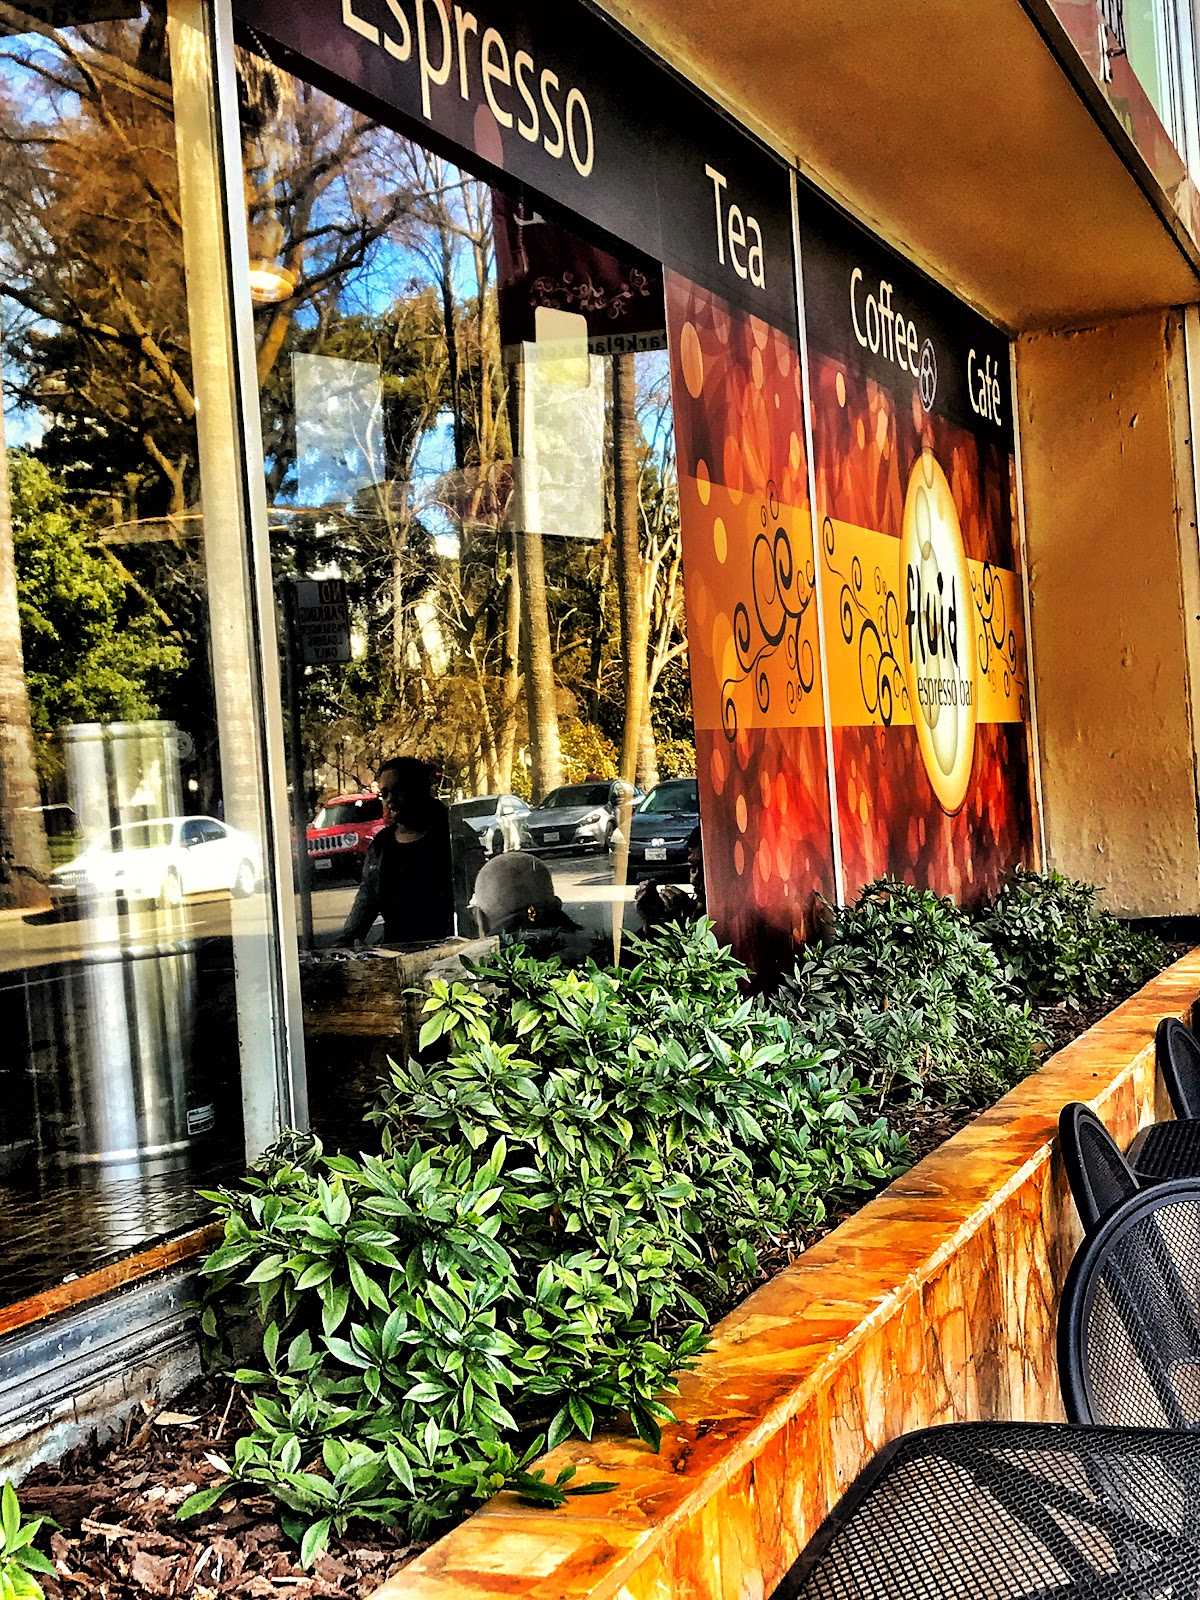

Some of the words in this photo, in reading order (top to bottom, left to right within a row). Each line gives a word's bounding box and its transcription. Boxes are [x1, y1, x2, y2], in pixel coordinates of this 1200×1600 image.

[342, 0, 595, 178] spresso
[705, 164, 766, 290] Tea
[850, 267, 920, 377] Coffee
[967, 348, 1002, 426] Café
[905, 563, 958, 668] fluid
[918, 676, 957, 719] espresso
[957, 664, 973, 706] bar
